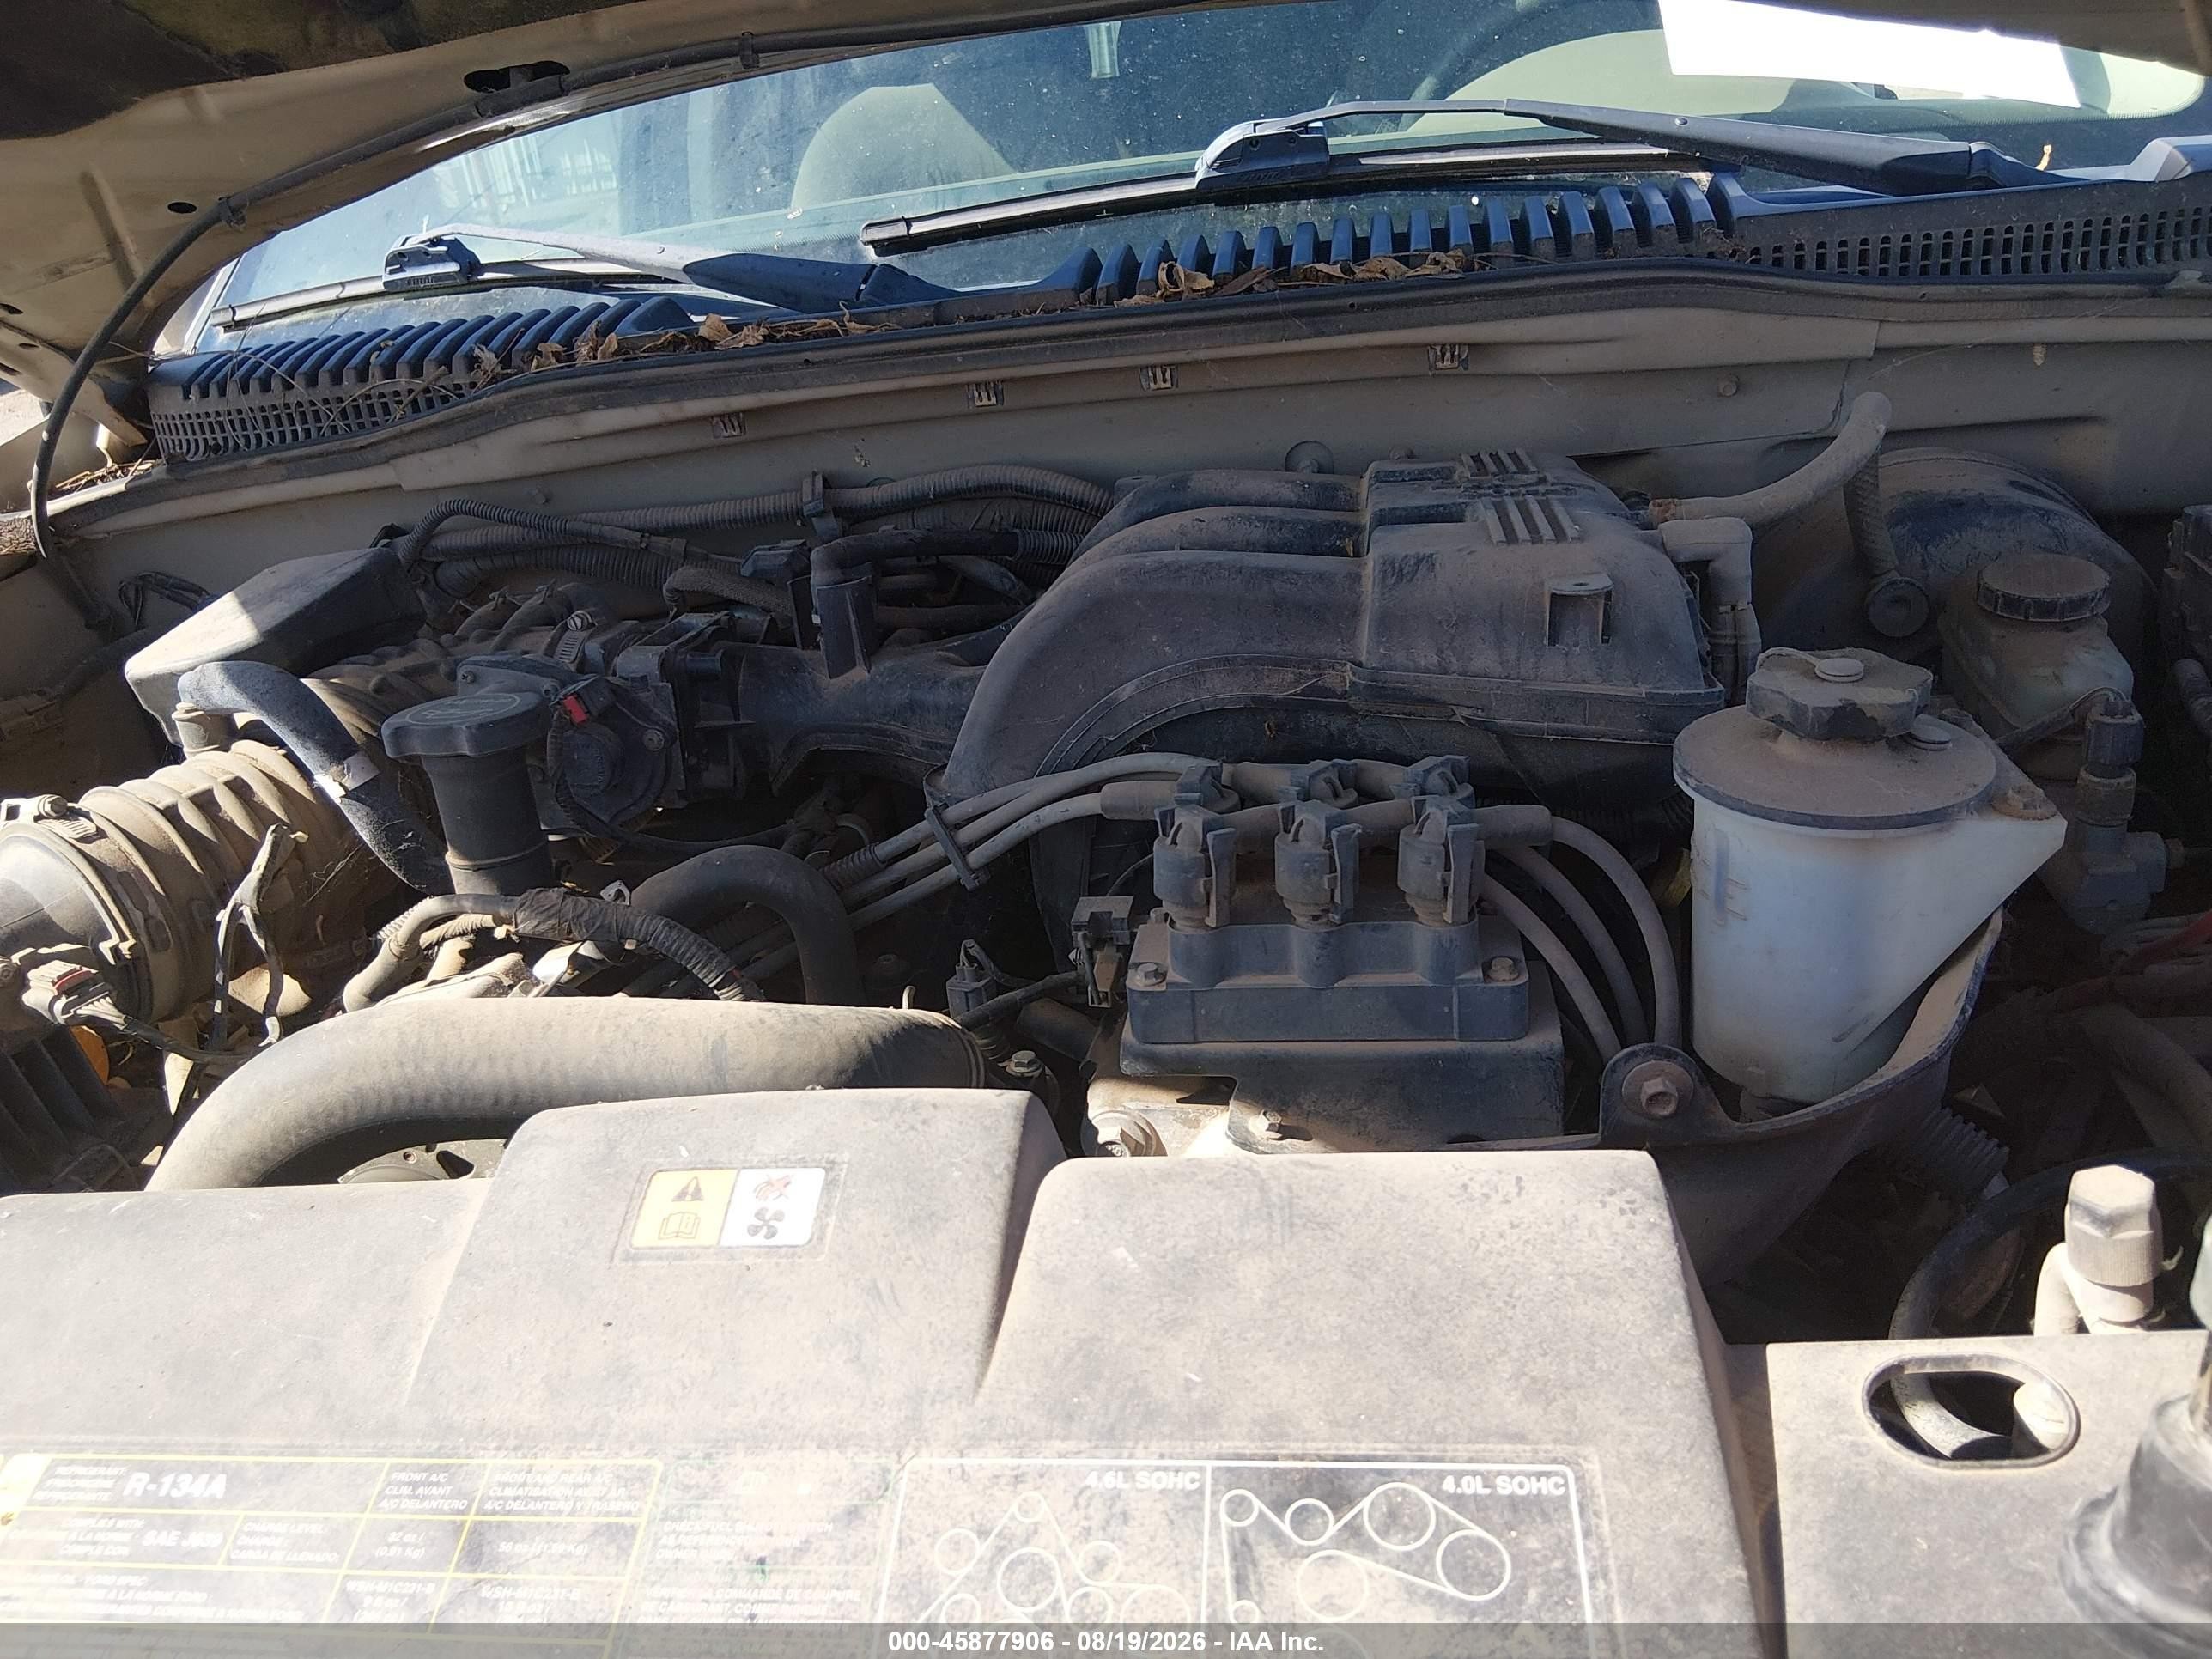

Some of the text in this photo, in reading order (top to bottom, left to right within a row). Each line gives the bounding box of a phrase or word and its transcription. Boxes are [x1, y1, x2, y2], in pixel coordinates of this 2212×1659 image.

[123, 1472, 227, 1499] R-134A
[1085, 1470, 1201, 1490] 4.6L SOHC
[1442, 1475, 1565, 1495] 4.0L SOHC
[416, 1486, 453, 1496] AVANT
[400, 1499, 467, 1510] DELANTERO
[506, 1500, 573, 1510] DELANTERO
[142, 1530, 181, 1547] SAE
